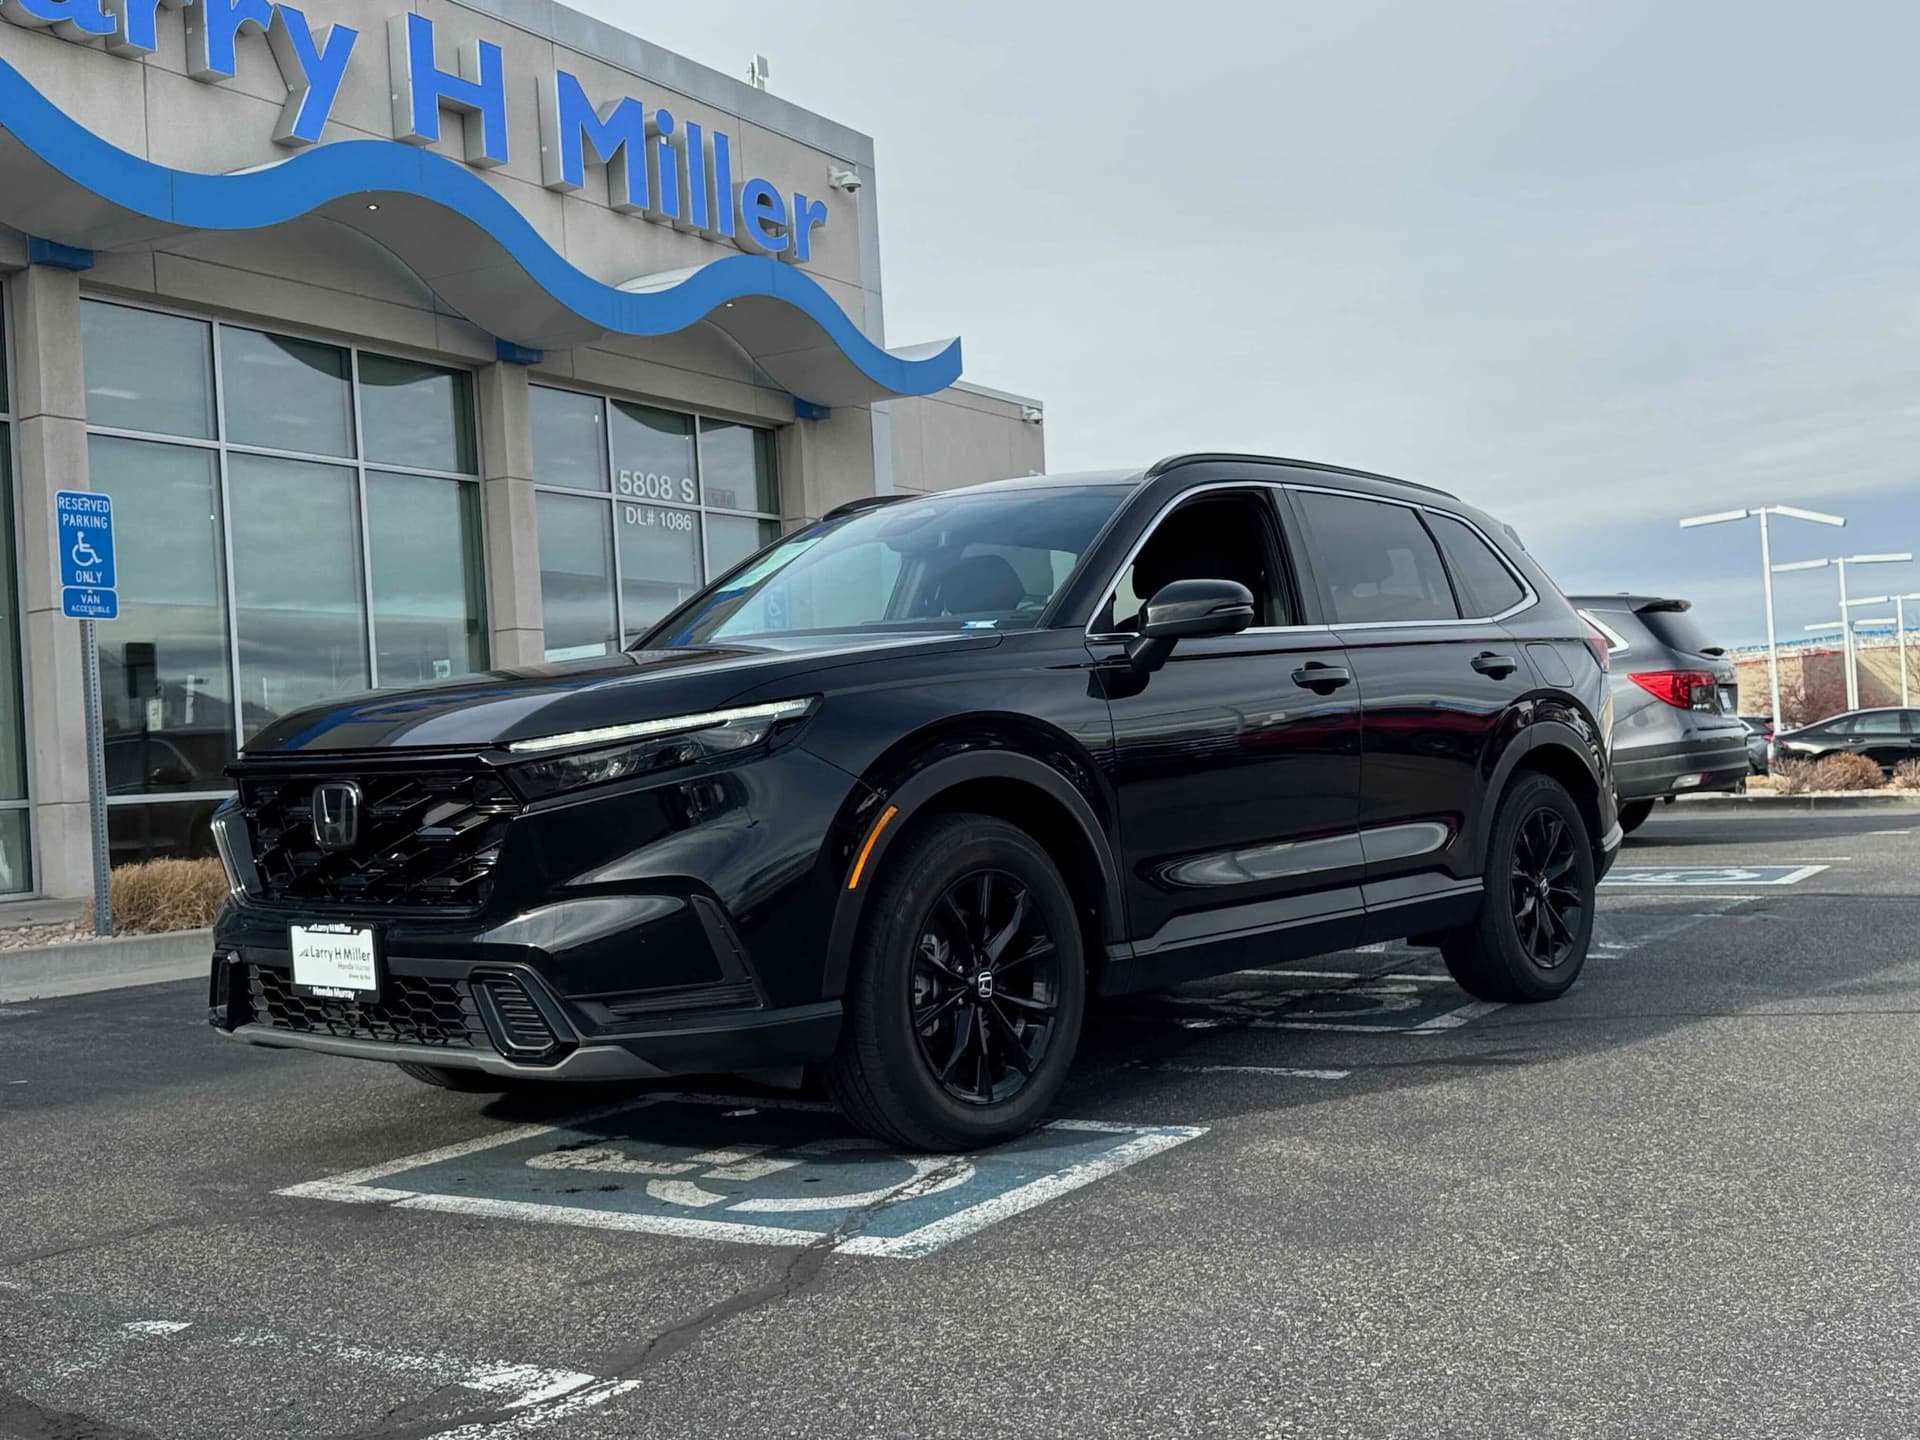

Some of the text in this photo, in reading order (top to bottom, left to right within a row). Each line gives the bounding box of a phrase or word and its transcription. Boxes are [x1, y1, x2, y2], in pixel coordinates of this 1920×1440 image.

[397, 12, 509, 167] H
[548, 69, 828, 263] Miller
[620, 469, 695, 503] 5808 S
[58, 497, 110, 513] RESERVED
[62, 514, 108, 529] PARKING
[626, 506, 692, 531] DL# 1086
[75, 570, 103, 584] ONLY
[81, 594, 101, 604] VAN
[71, 605, 111, 614] ACCESSIBLE
[310, 945, 371, 962] Larry H Miller
[313, 986, 333, 997] Honda
